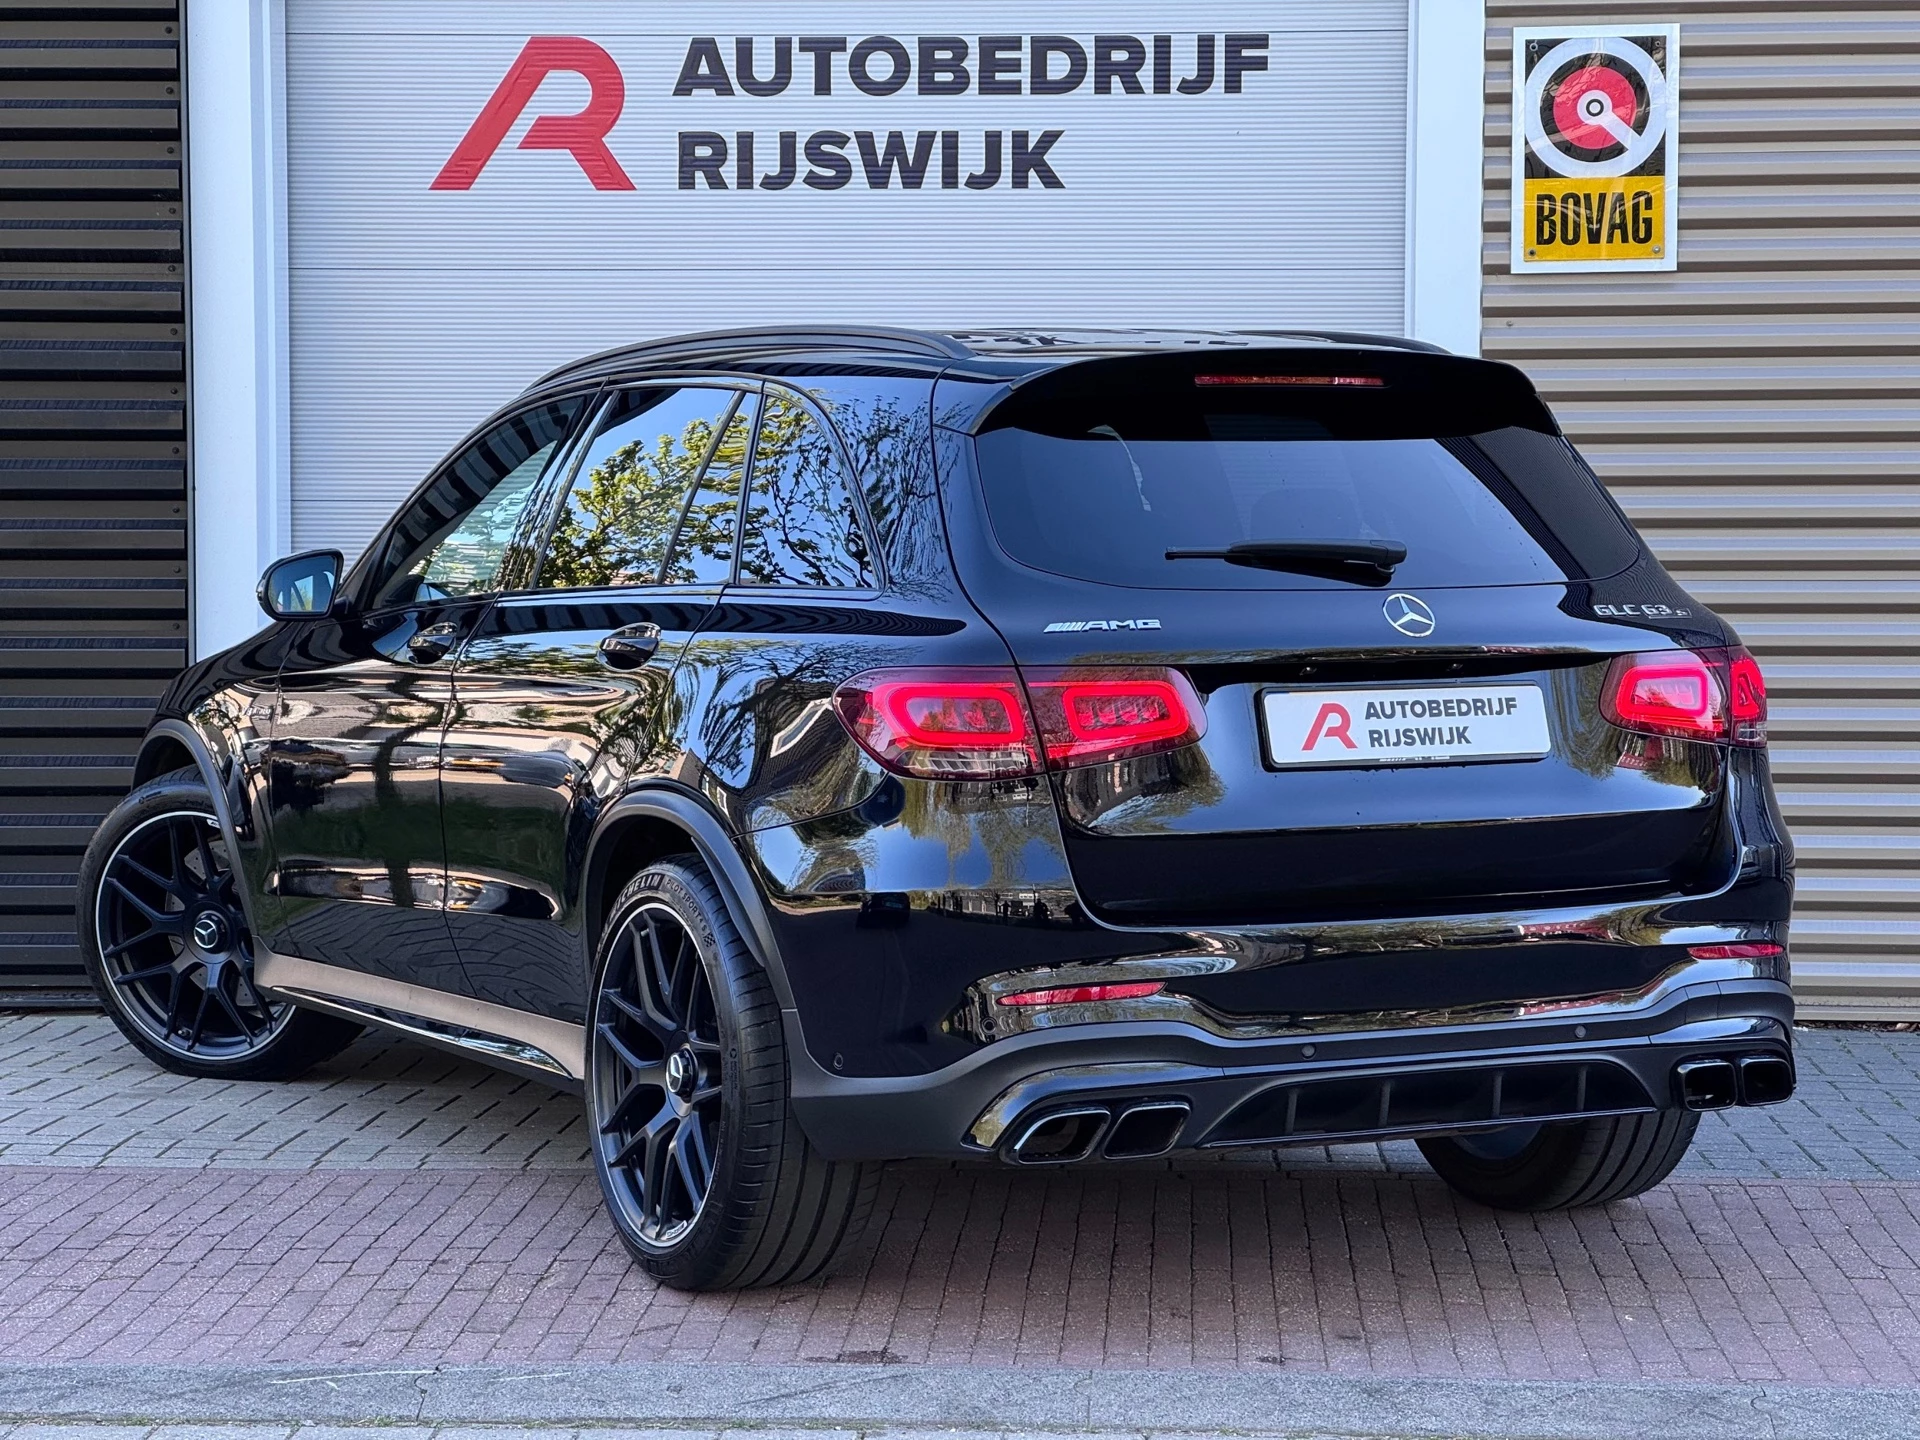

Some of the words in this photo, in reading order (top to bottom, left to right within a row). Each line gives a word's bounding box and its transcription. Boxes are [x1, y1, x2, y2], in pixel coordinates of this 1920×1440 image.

[672, 34, 1270, 97] AUTOBEDRIJF
[678, 130, 1067, 191] RIJSWIJK
[1535, 190, 1653, 246] BOVAG
[1593, 604, 1641, 616] GLC
[1641, 604, 1673, 617] 63
[1081, 619, 1162, 633] AMG
[1364, 696, 1518, 721] AUTOBEDRIJF
[1368, 725, 1473, 748] RIJSWIJK
